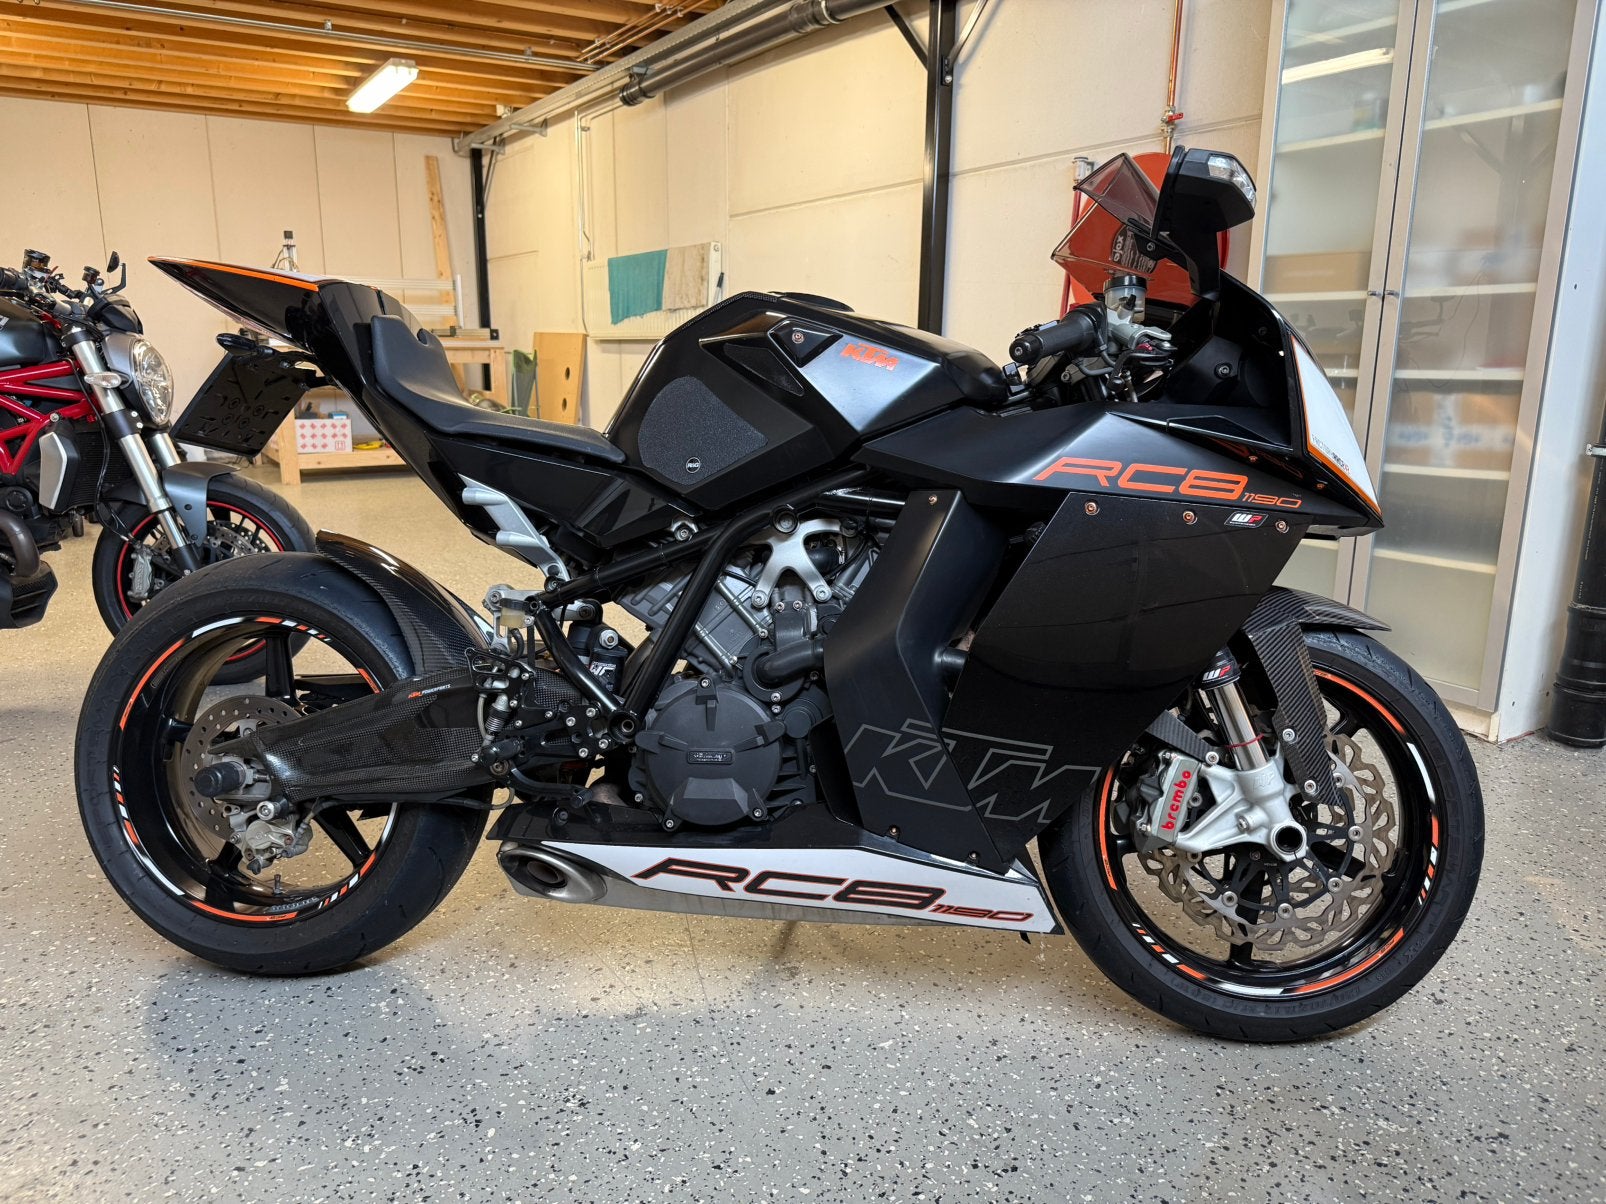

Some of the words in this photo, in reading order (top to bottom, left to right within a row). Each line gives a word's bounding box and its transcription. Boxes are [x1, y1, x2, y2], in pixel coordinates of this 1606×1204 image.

[841, 343, 899, 371] KTM
[1032, 456, 1248, 500] RC8
[1242, 492, 1302, 509] 1190
[1231, 513, 1263, 525] WP
[1202, 665, 1231, 681] WP
[844, 717, 1102, 824] KTM
[1160, 770, 1192, 830] brembo
[631, 857, 947, 910] RC8
[928, 903, 1033, 922] 1190
